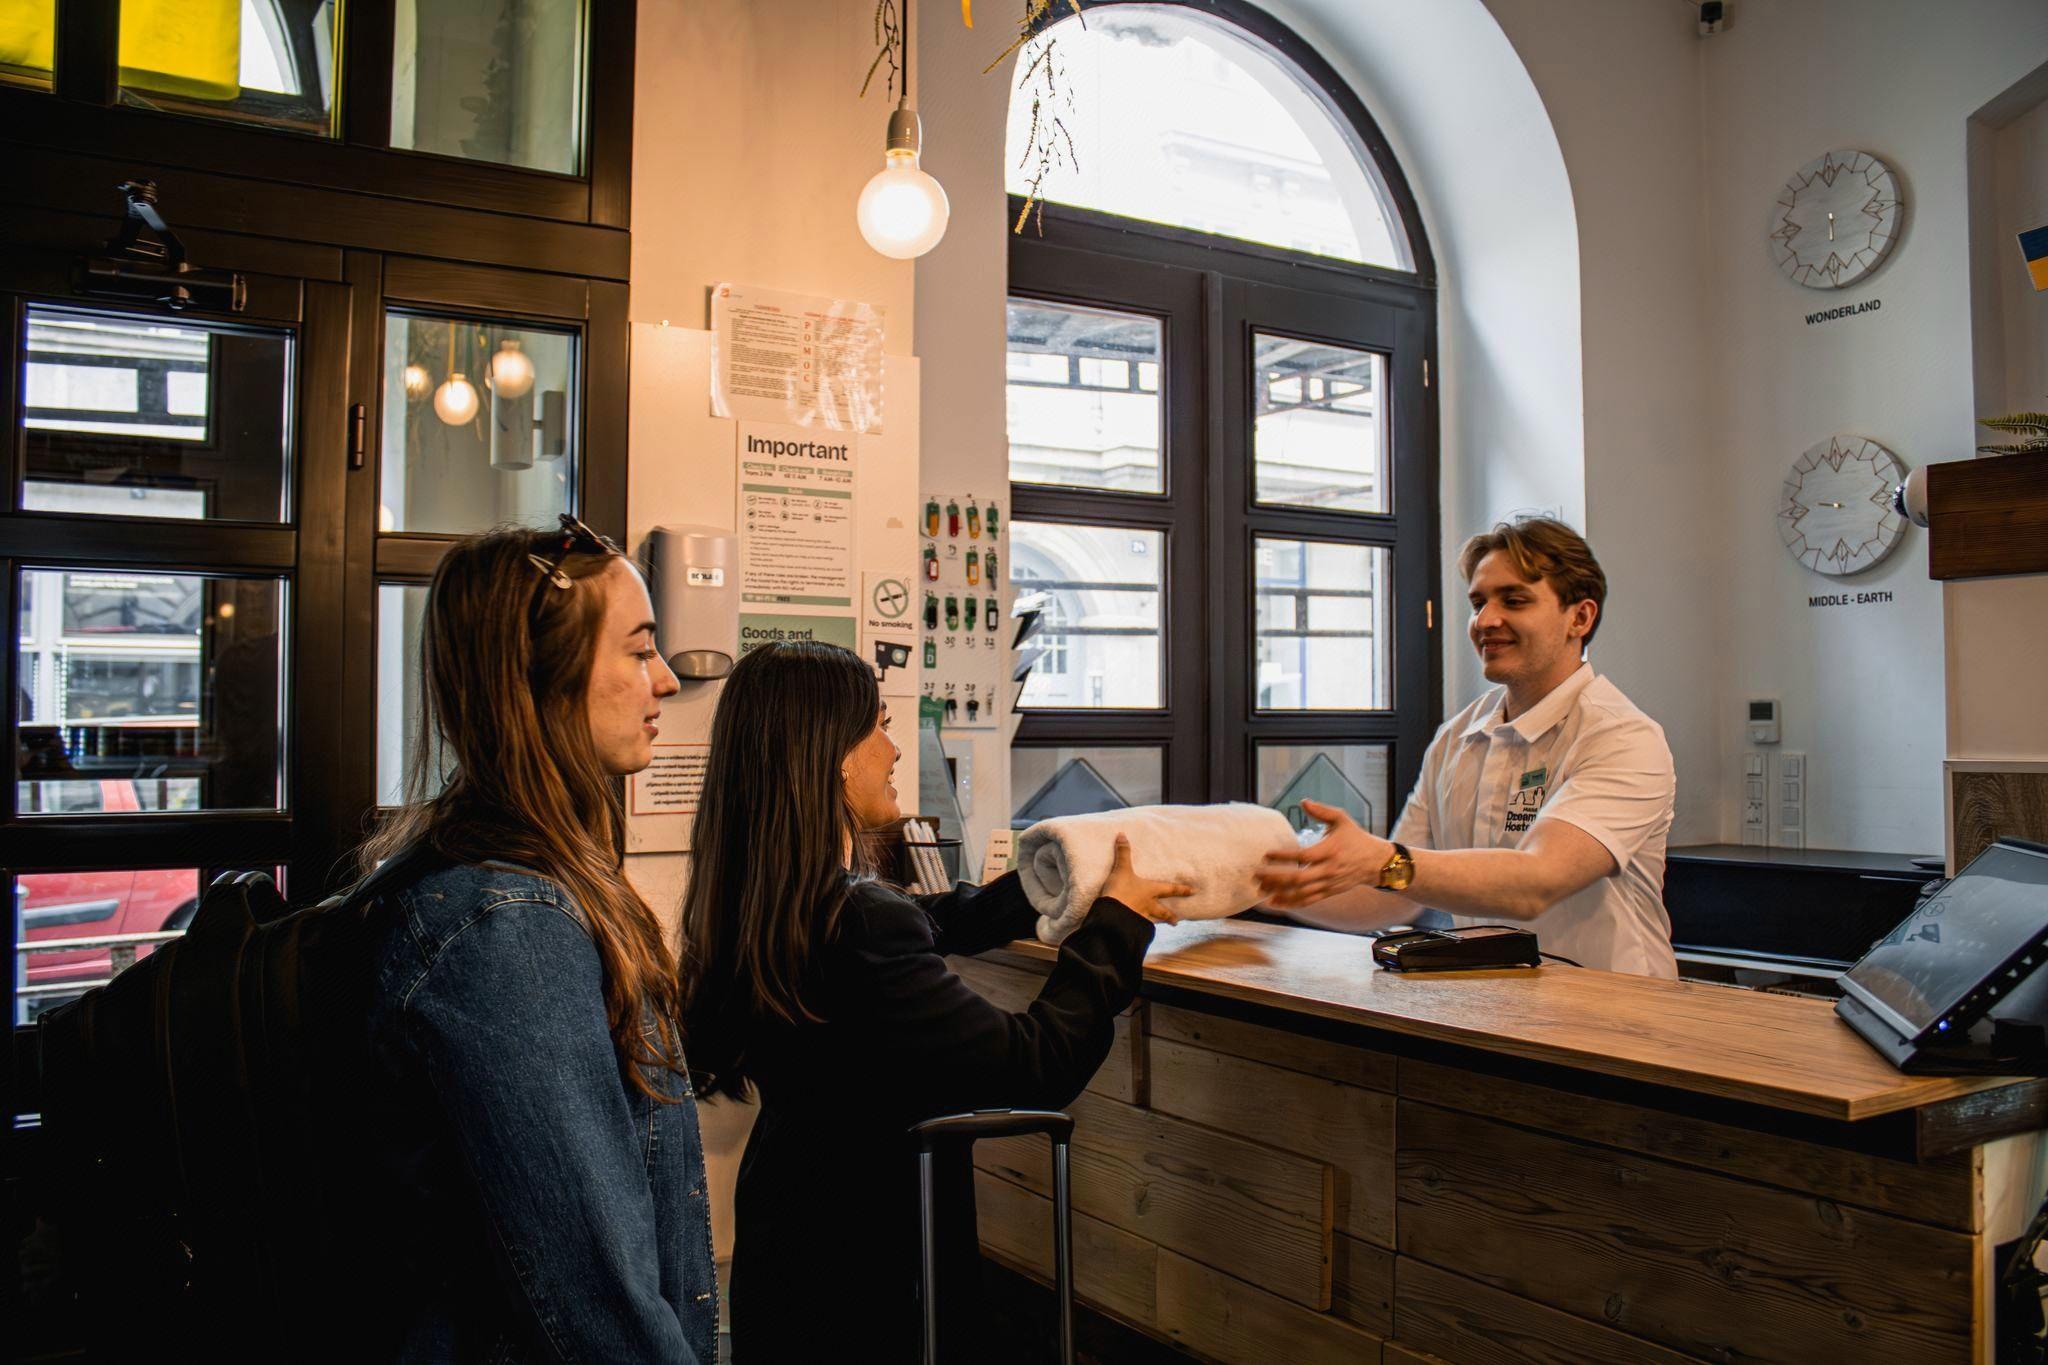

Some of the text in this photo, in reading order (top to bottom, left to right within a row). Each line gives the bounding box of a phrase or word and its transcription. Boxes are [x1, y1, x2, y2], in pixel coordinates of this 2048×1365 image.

[1805, 299, 1881, 325] WONDERLAND
[747, 434, 848, 461] Important
[1808, 594, 1848, 607] MIDDLE
[1857, 591, 1893, 604] EARTH
[868, 619, 913, 630] No smoking
[741, 626, 813, 640] Goods and
